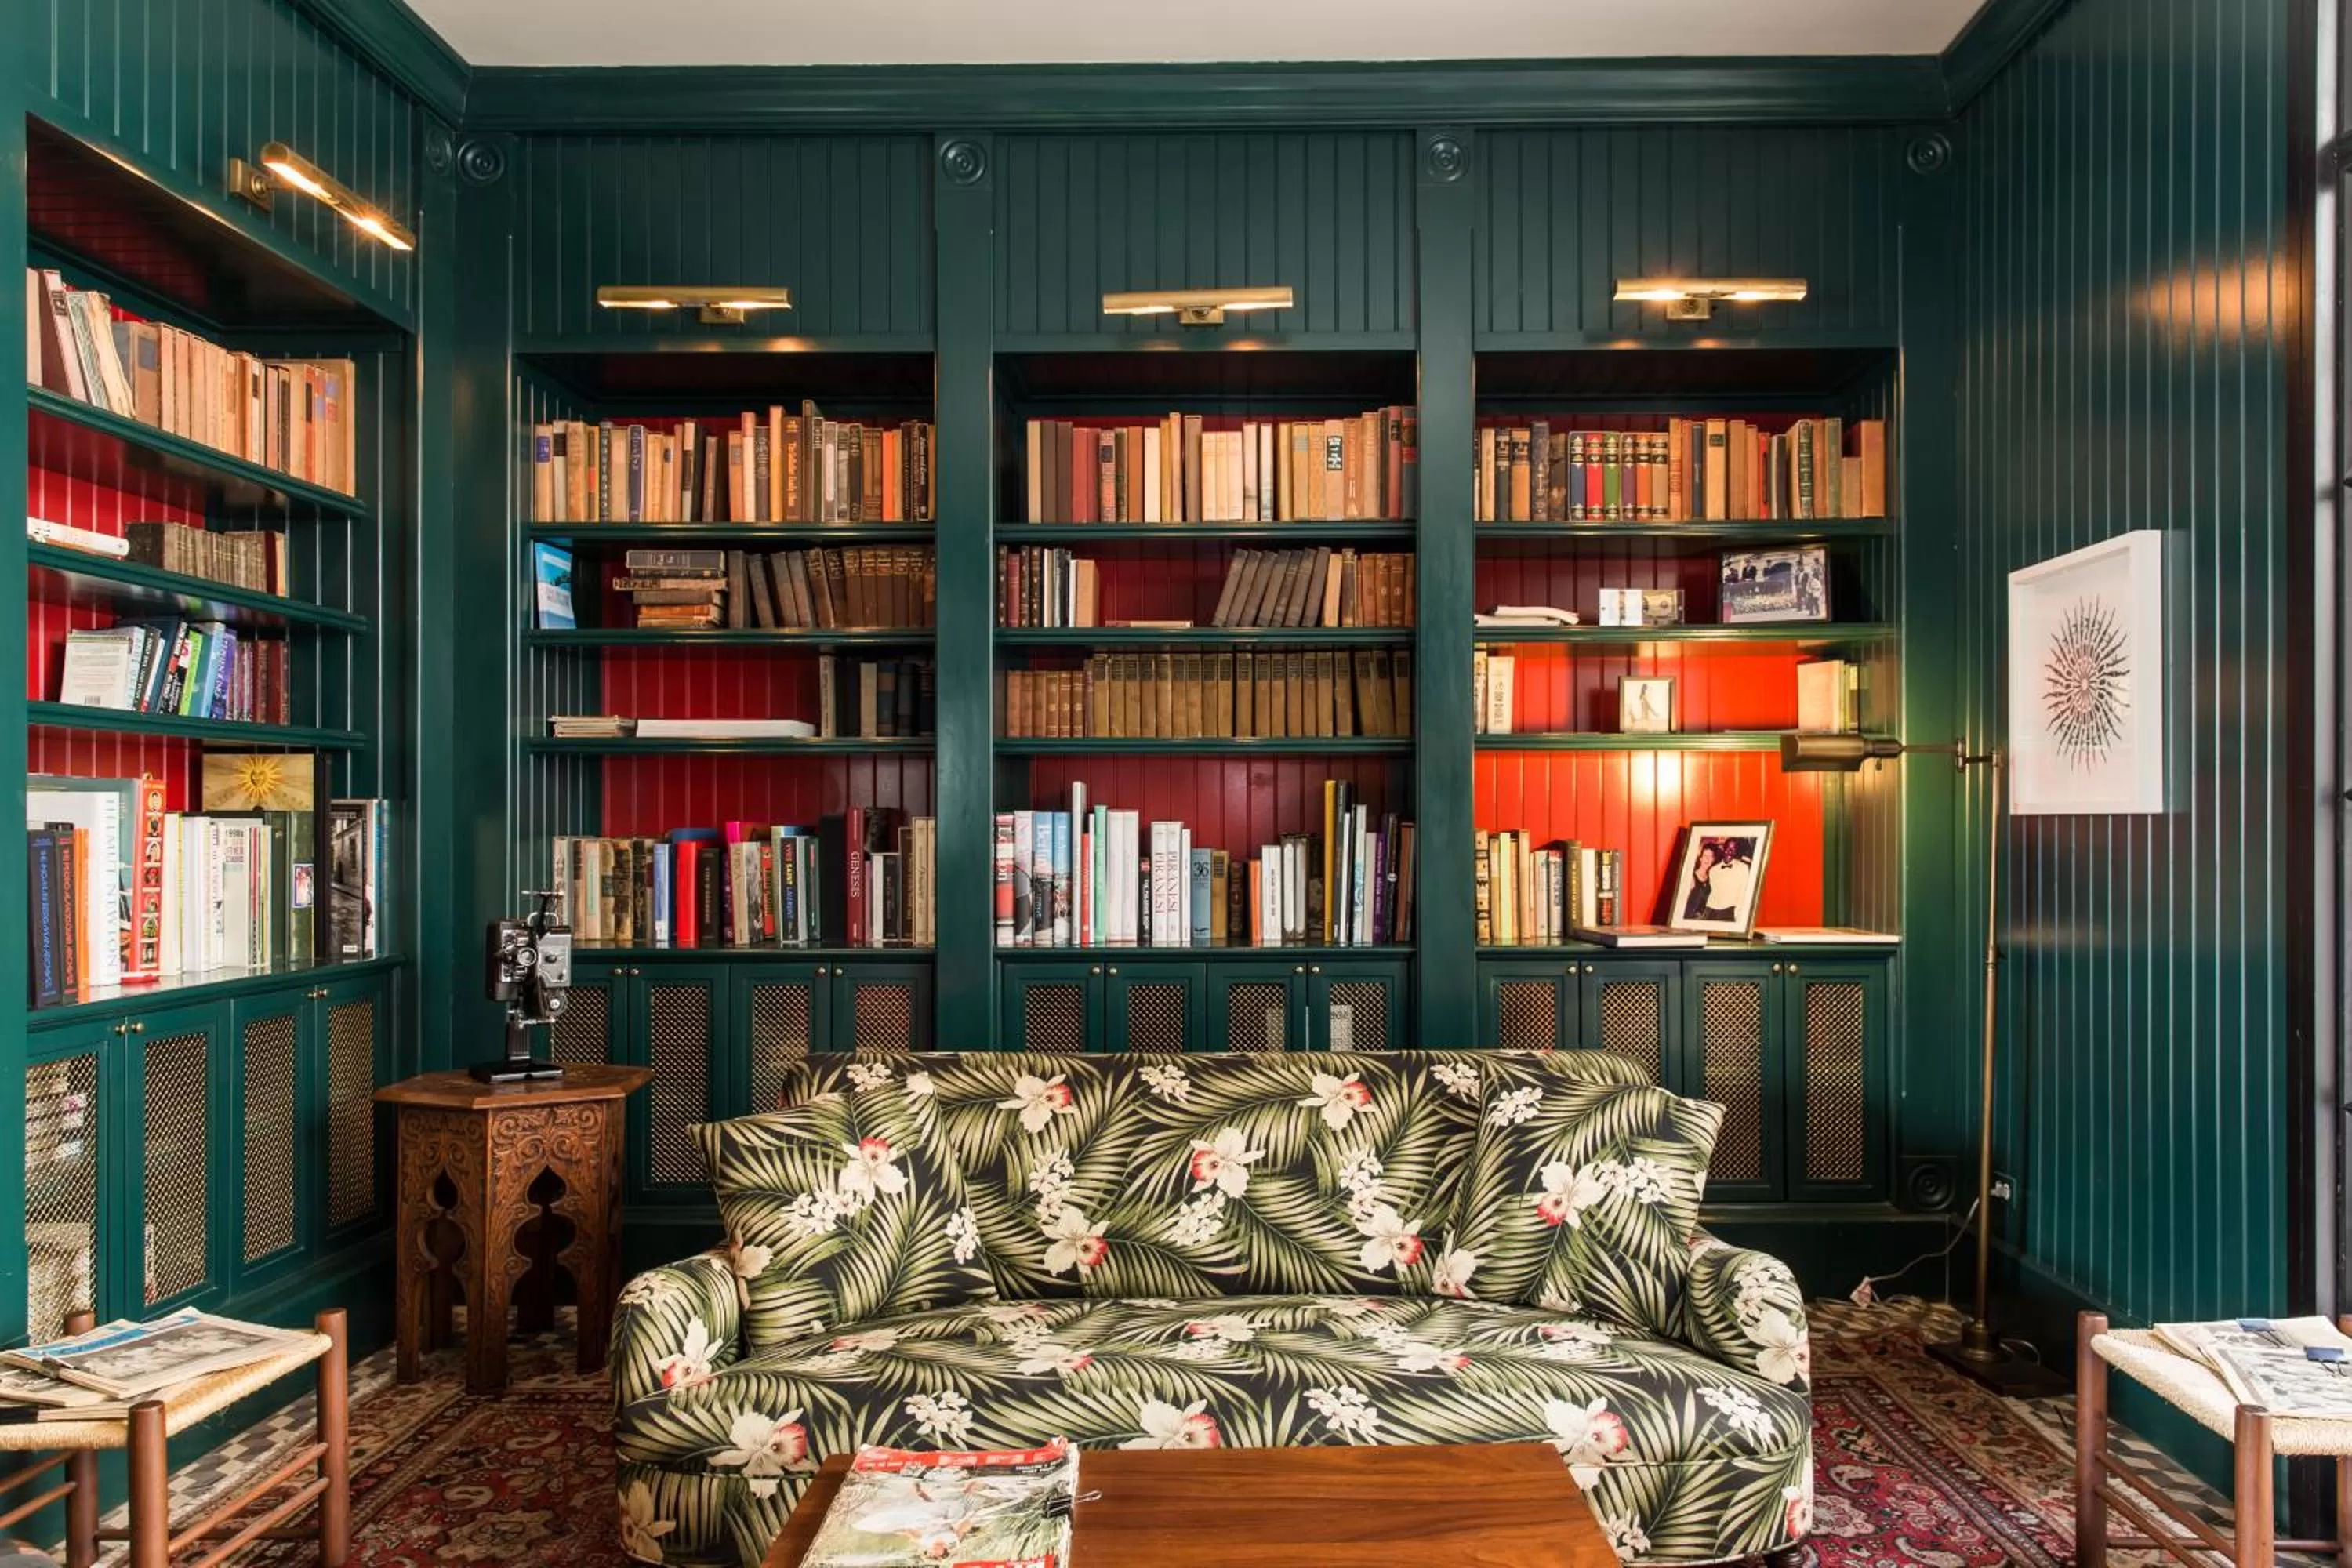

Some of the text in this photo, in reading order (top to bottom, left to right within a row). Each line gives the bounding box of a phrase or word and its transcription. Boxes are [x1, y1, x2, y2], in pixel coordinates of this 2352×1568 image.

[997, 826, 1014, 881] Loon
[1036, 823, 1051, 866] Berlin
[104, 799, 119, 968] HELMUT NEWTON
[785, 863, 793, 885] SAINT
[850, 850, 861, 898] GENESIS
[1154, 851, 1165, 915] PIRANESI
[1167, 850, 1178, 914] PIRANESI
[1193, 861, 1210, 877] 36
[786, 887, 794, 920] LAURENT
